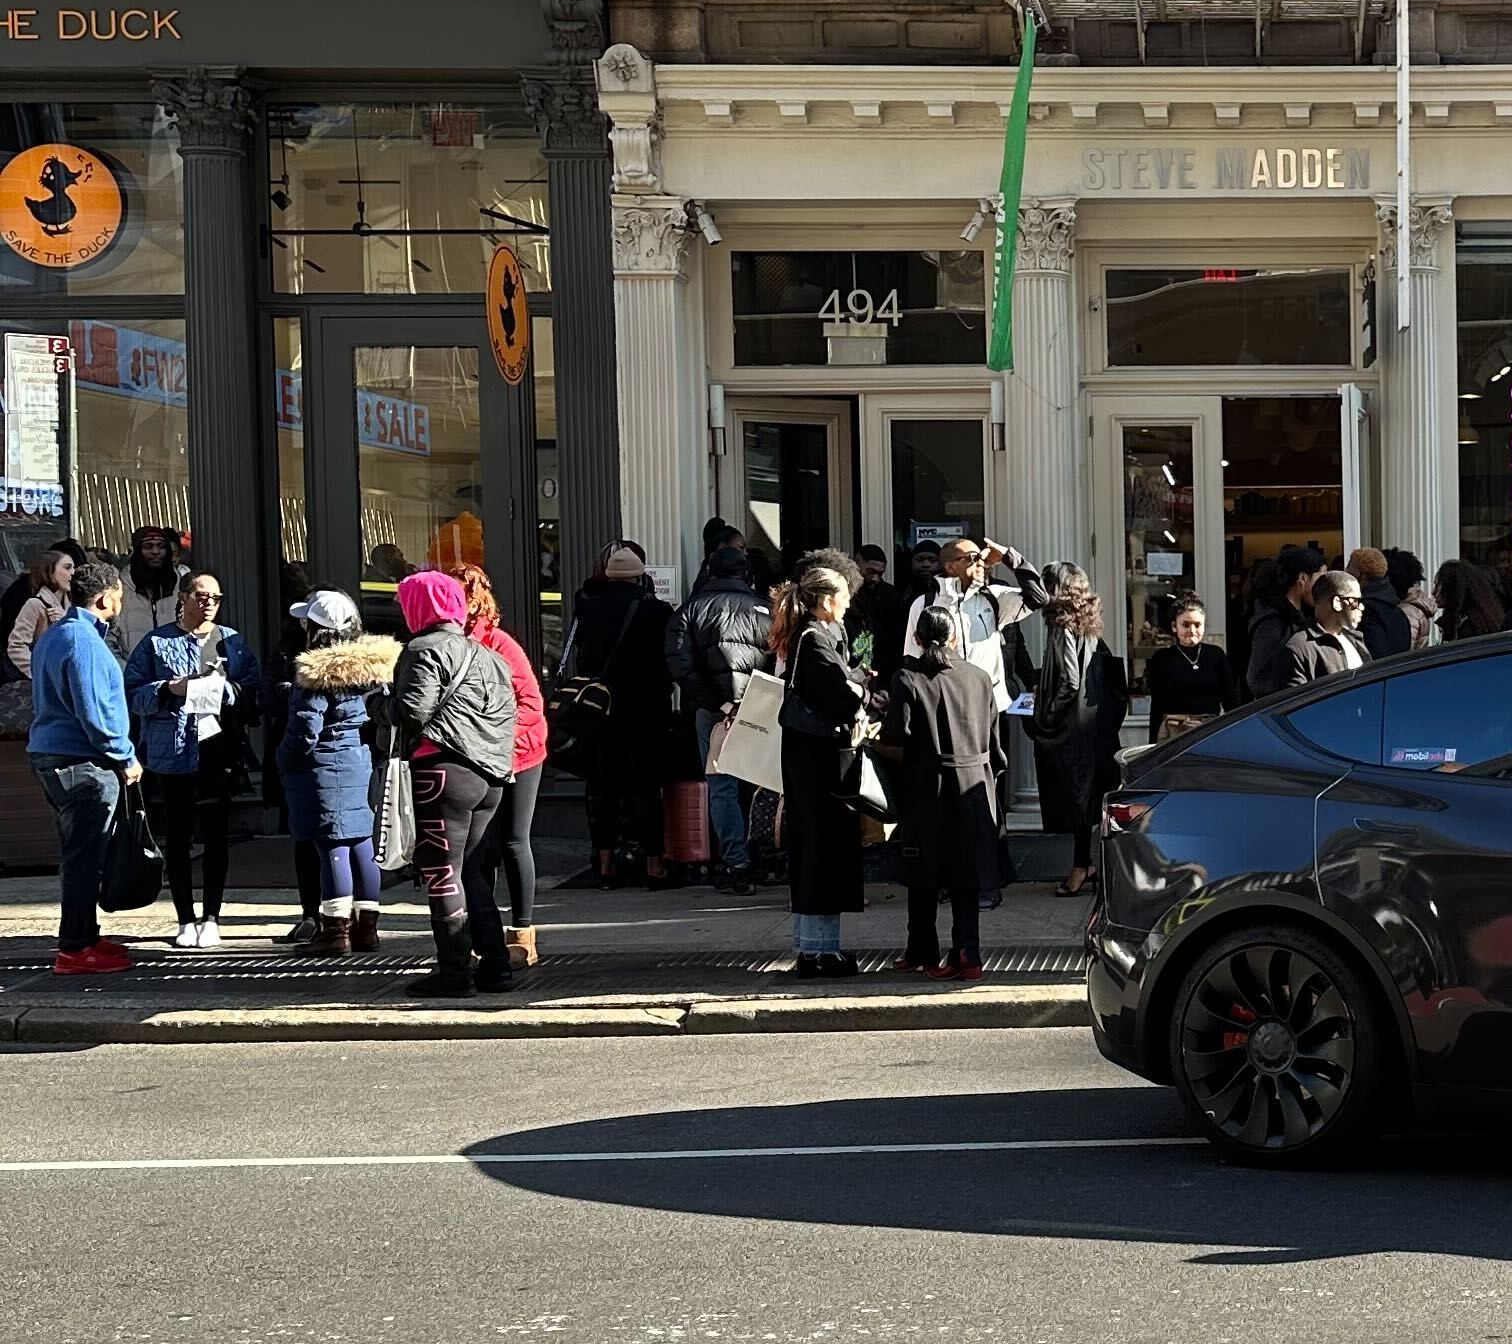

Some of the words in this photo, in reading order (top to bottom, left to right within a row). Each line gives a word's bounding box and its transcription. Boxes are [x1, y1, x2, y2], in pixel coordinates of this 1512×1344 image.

[58, 10, 181, 40] DUCK
[1082, 148, 1196, 190] STEVE
[1213, 147, 1370, 190] MADDEN
[6, 230, 40, 260] SAVE
[44, 252, 74, 263] THE
[78, 226, 114, 259] DUCK
[818, 288, 903, 327] 494
[376, 400, 427, 452] SALE
